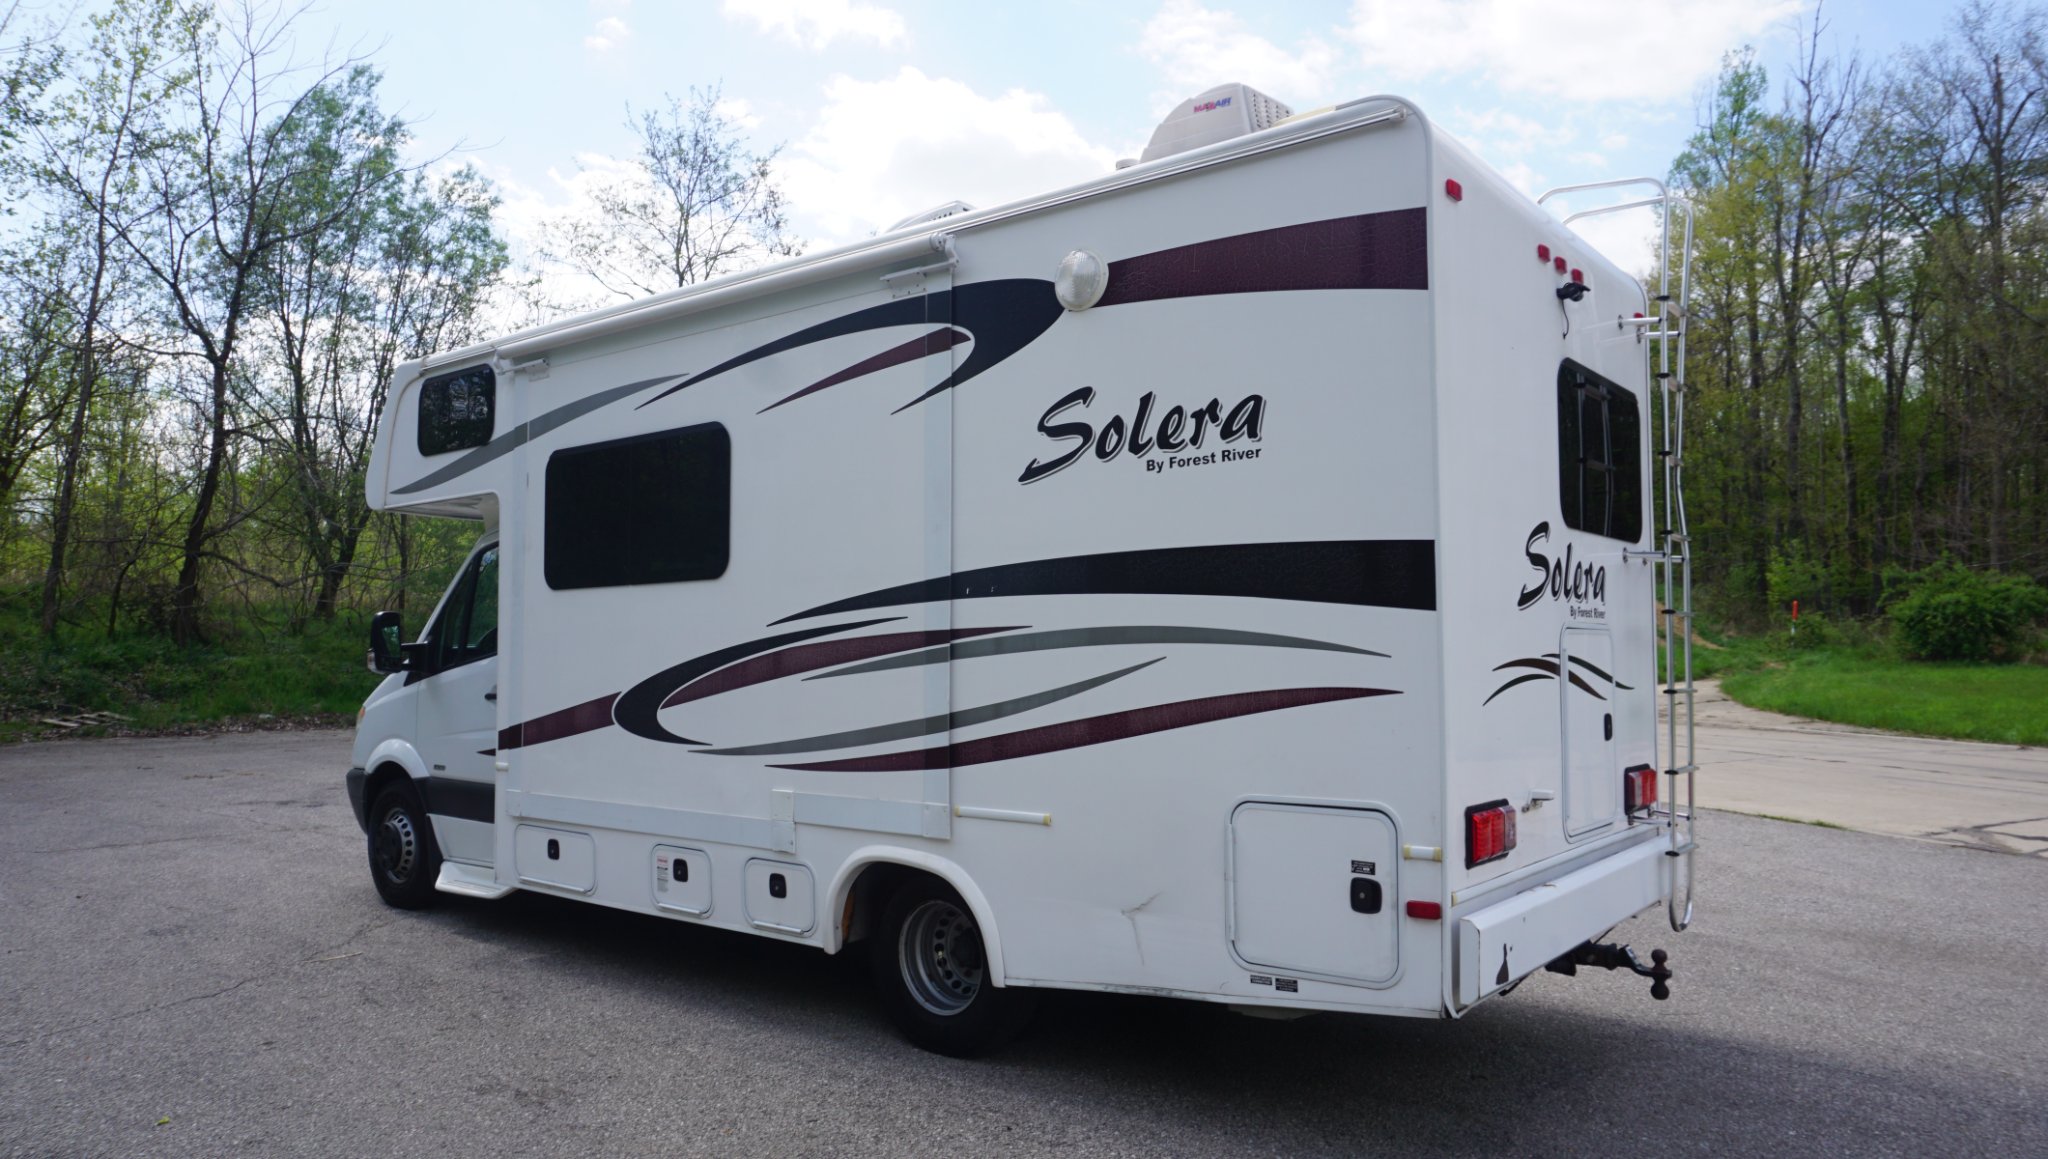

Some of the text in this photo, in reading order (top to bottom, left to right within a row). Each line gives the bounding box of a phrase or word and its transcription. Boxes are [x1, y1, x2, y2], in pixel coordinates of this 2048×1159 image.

[1018, 385, 1267, 485] Solera
[1146, 448, 1262, 473] By Forest River
[1517, 521, 1606, 611] Solera
[1570, 605, 1606, 619] By Forest River
